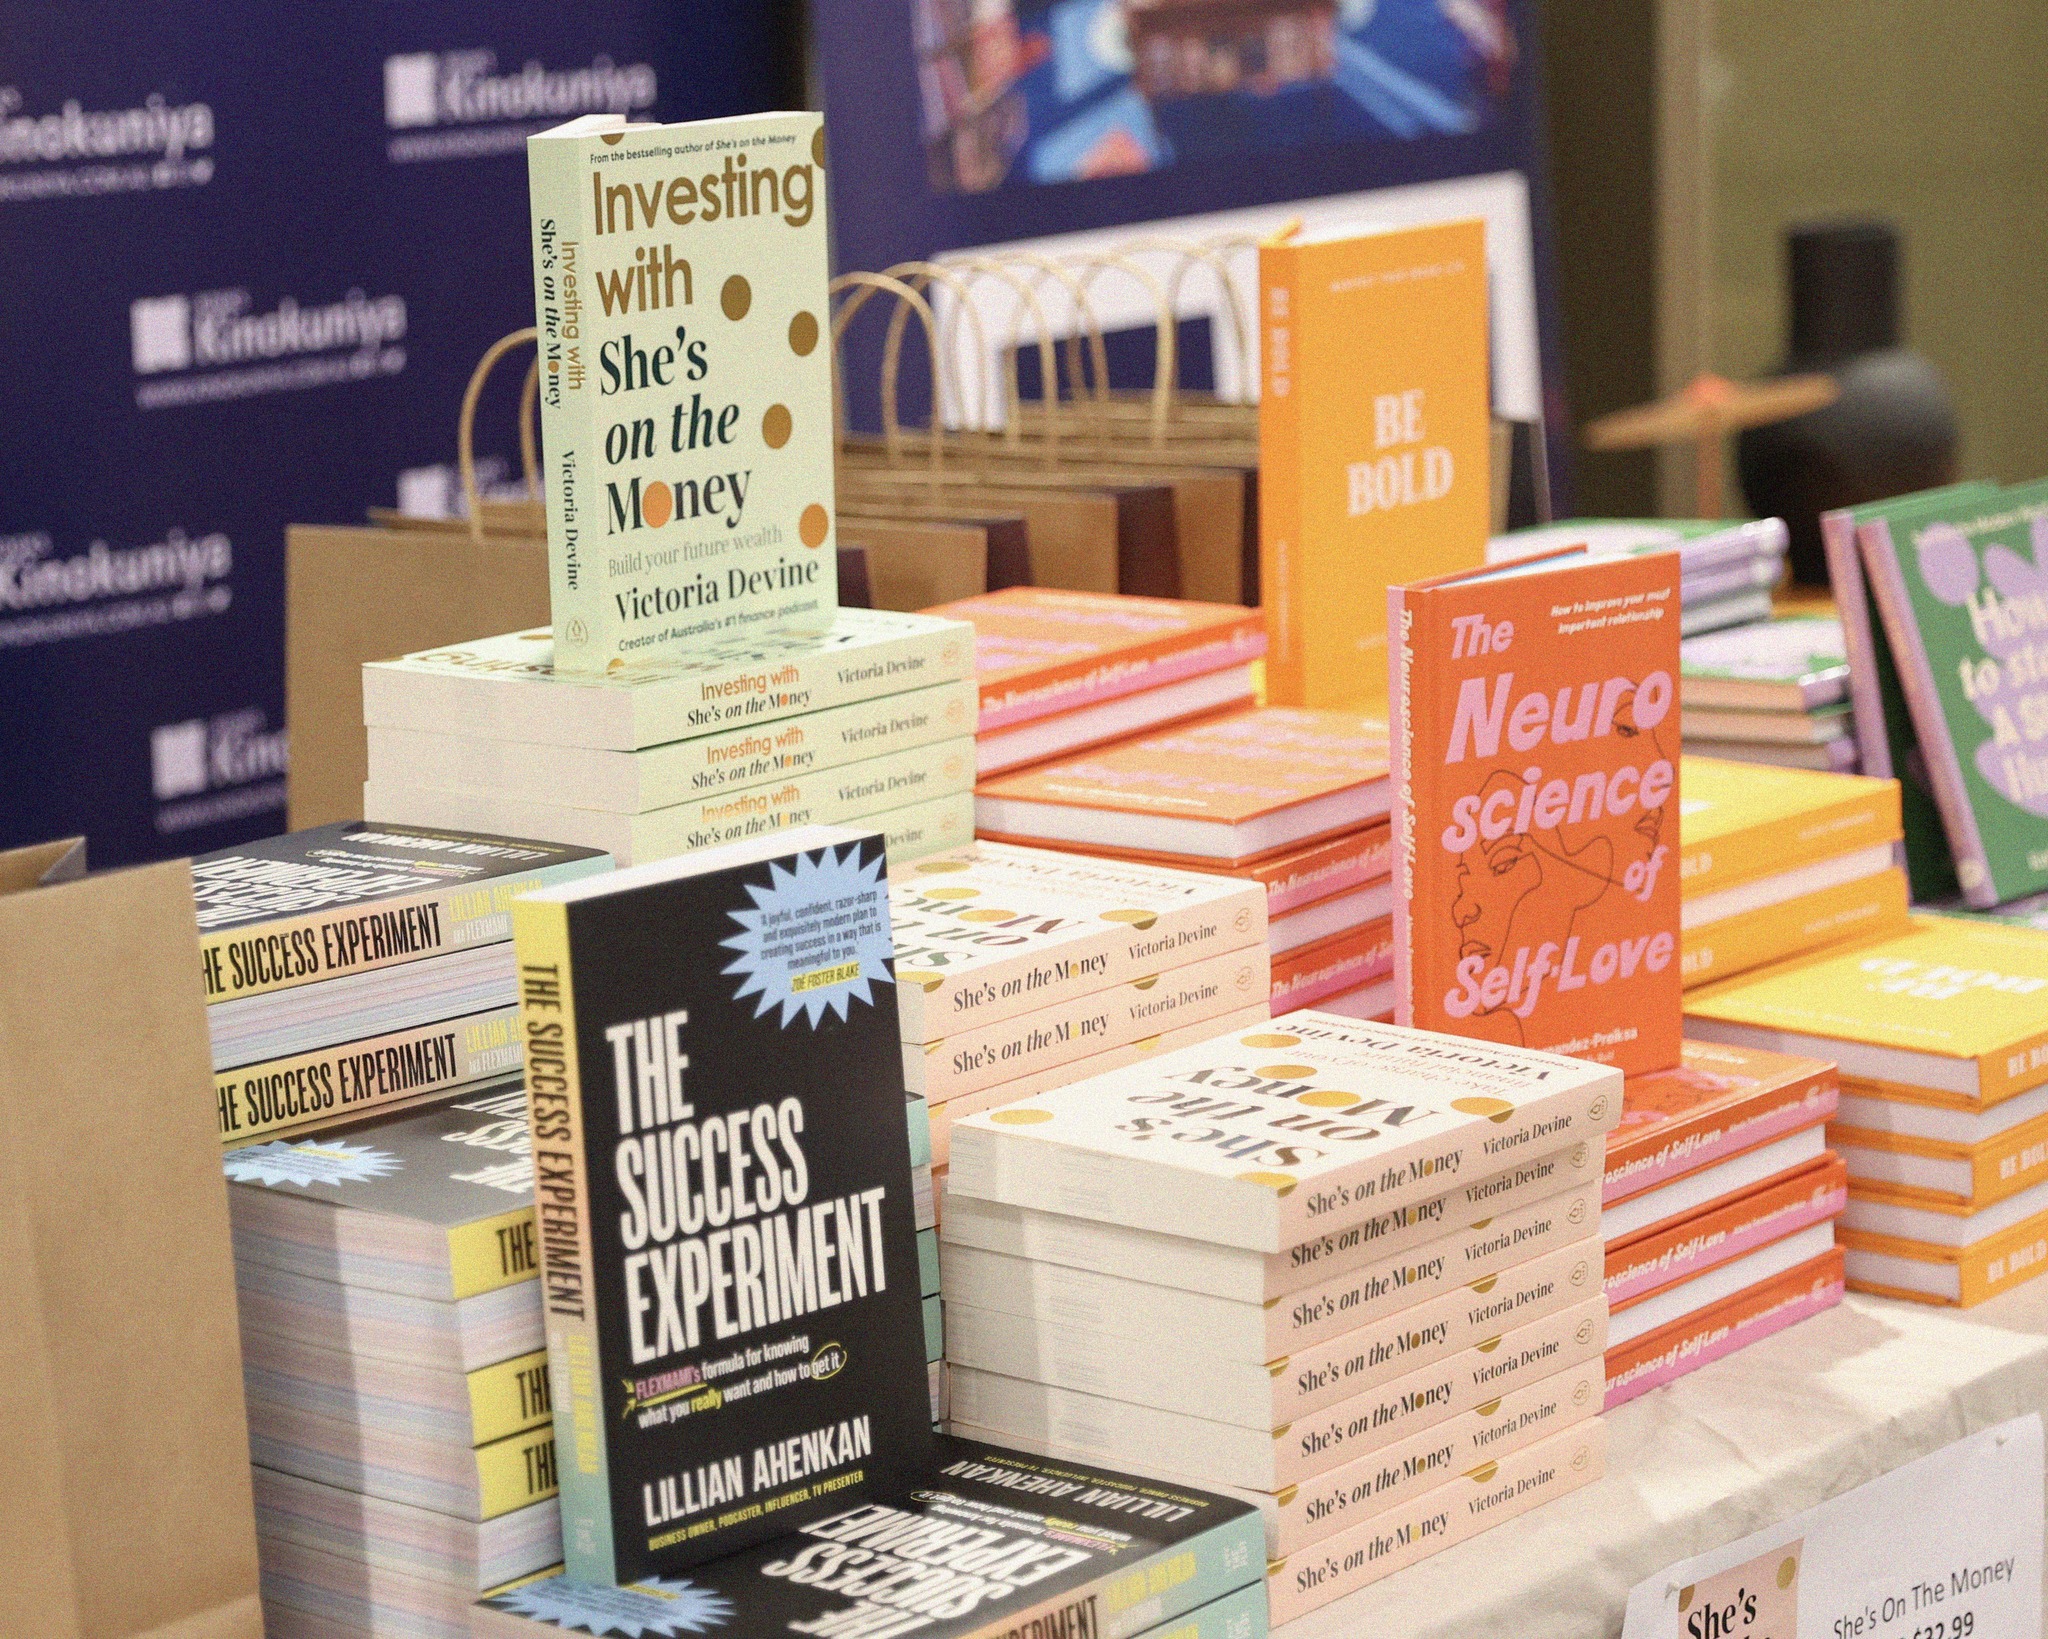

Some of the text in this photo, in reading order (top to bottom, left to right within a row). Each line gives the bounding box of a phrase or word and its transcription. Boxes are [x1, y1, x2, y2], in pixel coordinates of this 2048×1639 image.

[590, 134, 797, 164] From the bestselling author of She's on the Money
[593, 153, 814, 235] Investing
[541, 218, 558, 268] She's
[544, 277, 556, 300] on
[596, 244, 693, 317] with
[545, 305, 559, 337] the
[561, 241, 586, 390] Investing with
[600, 326, 708, 396] She's
[605, 393, 740, 464] on the
[1373, 388, 1427, 450] BE
[606, 469, 752, 535] Money
[1346, 445, 1456, 517] BOLD
[561, 450, 581, 590] Victoria Devine
[608, 524, 782, 578] Build your future wealth
[616, 556, 819, 623] Victoria Devine
[1551, 605, 1572, 617] How
[1573, 602, 1584, 613] to
[1622, 594, 1645, 609] your
[1646, 588, 1670, 602] most
[1608, 608, 1664, 626] relationship
[618, 599, 818, 652] Creator of Australia's #1 finance podcast
[1400, 609, 1413, 642] The
[1450, 613, 1514, 660] The
[701, 655, 926, 701] Investing with Victoria Devine
[687, 705, 721, 728] She's
[725, 702, 742, 718] on
[745, 696, 766, 714] the
[707, 714, 929, 764] Investing with Victoria Devine
[1399, 645, 1415, 781] Neuroscience
[1445, 670, 1673, 764] Neuro
[691, 768, 725, 790] She's
[729, 764, 746, 782] on
[749, 758, 770, 777] the
[701, 771, 928, 824] Investing with Victoria Devine
[1400, 784, 1415, 807] of
[686, 826, 722, 850] She's
[725, 823, 742, 842] on
[745, 818, 766, 836] the
[1441, 758, 1674, 853] science
[1623, 844, 1670, 901] of
[449, 892, 496, 922] LILLIAN
[202, 902, 442, 996] HE SUCCESS EXPERIMENT
[953, 982, 996, 1013] She's
[1002, 974, 1022, 998] on
[1026, 966, 1052, 990] the
[1128, 934, 1176, 961] Victoria
[1177, 922, 1218, 949] Devine
[1443, 931, 1674, 1018] Self-Love
[522, 963, 563, 1014] THE
[953, 1044, 996, 1076] She's
[1002, 1036, 1022, 1060] on
[1026, 1028, 1052, 1052] the
[1128, 995, 1176, 1022] Victoria
[1178, 983, 1218, 1006] Devine
[216, 1033, 457, 1133] HE SUCCESS EXPERIMENT
[527, 1021, 572, 1142] SUCCESS
[605, 1010, 694, 1135] THE
[1113, 1115, 1324, 1168] She's
[1125, 1090, 1381, 1142] on the
[614, 1096, 809, 1250] SUCCESS
[1307, 1185, 1350, 1219] She's
[1355, 1177, 1376, 1200] on
[1380, 1166, 1406, 1191] the
[1482, 1130, 1530, 1156] Victoria
[1532, 1113, 1573, 1140] Devine
[496, 1220, 538, 1277] THE
[536, 1149, 584, 1321] EXPERIMENT
[624, 1186, 886, 1364] EXPERIMENT
[702, 1353, 745, 1380] formula
[746, 1350, 762, 1367] for
[763, 1334, 810, 1362] knowing
[638, 1352, 840, 1429] what you really want and how to get it
[1301, 1424, 1343, 1458] She's
[1348, 1415, 1368, 1438] on
[1373, 1403, 1398, 1429] the
[1472, 1359, 1519, 1386] Victoria
[1520, 1340, 1560, 1366] Devine
[643, 1414, 872, 1527] LILLIAN AHENKAN
[812, 1484, 822, 1498] TV
[823, 1470, 864, 1494] PRESENTER
[939, 1461, 1196, 1523] LILLIAN AHENKAN
[1687, 1587, 1757, 1639] She's
[1834, 1557, 2016, 1639] She's On The Money
